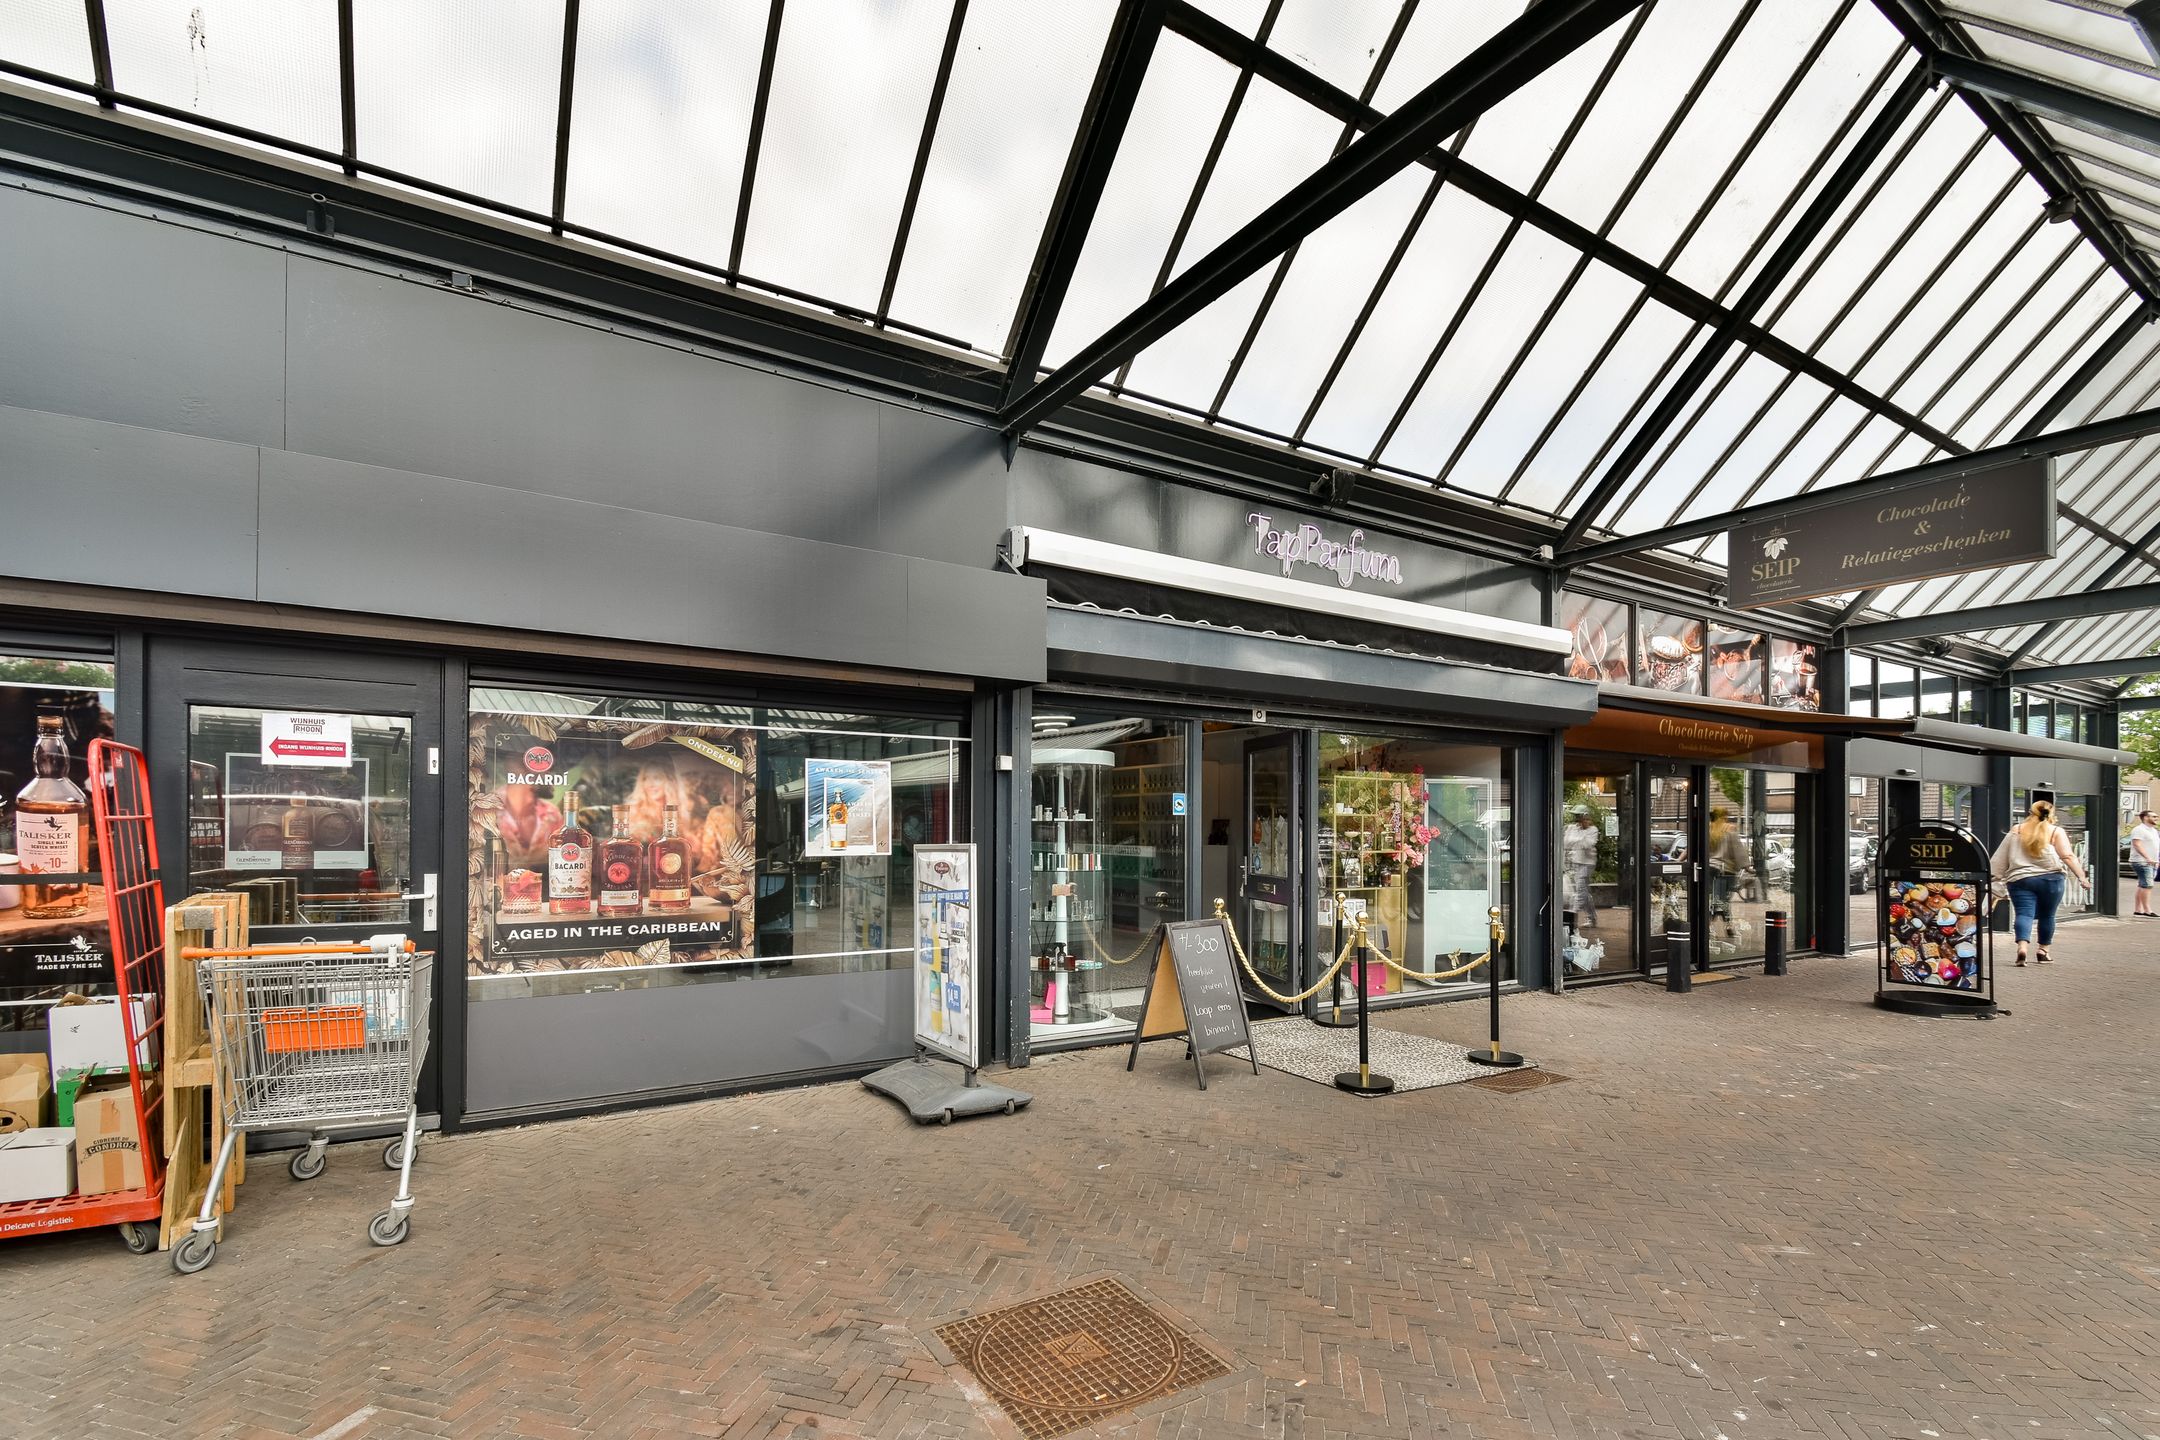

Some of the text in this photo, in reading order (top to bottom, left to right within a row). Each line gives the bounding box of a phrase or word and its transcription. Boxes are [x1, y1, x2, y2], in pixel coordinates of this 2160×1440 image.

[1876, 493, 1971, 524] Chocolade
[1913, 520, 1932, 536] &
[1247, 512, 1402, 587] TapParfum
[1841, 528, 2012, 569] Relatiegeschenken
[1751, 557, 1801, 582] SEIP
[290, 717, 326, 725] WIJNHUIS
[295, 725, 321, 733] RHOON
[1659, 718, 1754, 748] Chocolaterie Seip
[389, 726, 406, 755] 7
[687, 737, 740, 768] ONTDEK NU
[1671, 763, 1676, 774] 9
[507, 771, 569, 786] BACARDÍ
[19, 830, 72, 840] TALISKER
[1910, 844, 1953, 858] SEIP
[49, 857, 61, 869] 10
[507, 921, 721, 941] AGED IN THE CARIBBEAN
[1194, 934, 1219, 954] 300
[35, 953, 103, 963] TALISKER
[1194, 1004, 1213, 1019] Loop
[88, 1141, 136, 1154] CONDROZ
[38, 1216, 74, 1227] Logistiek
